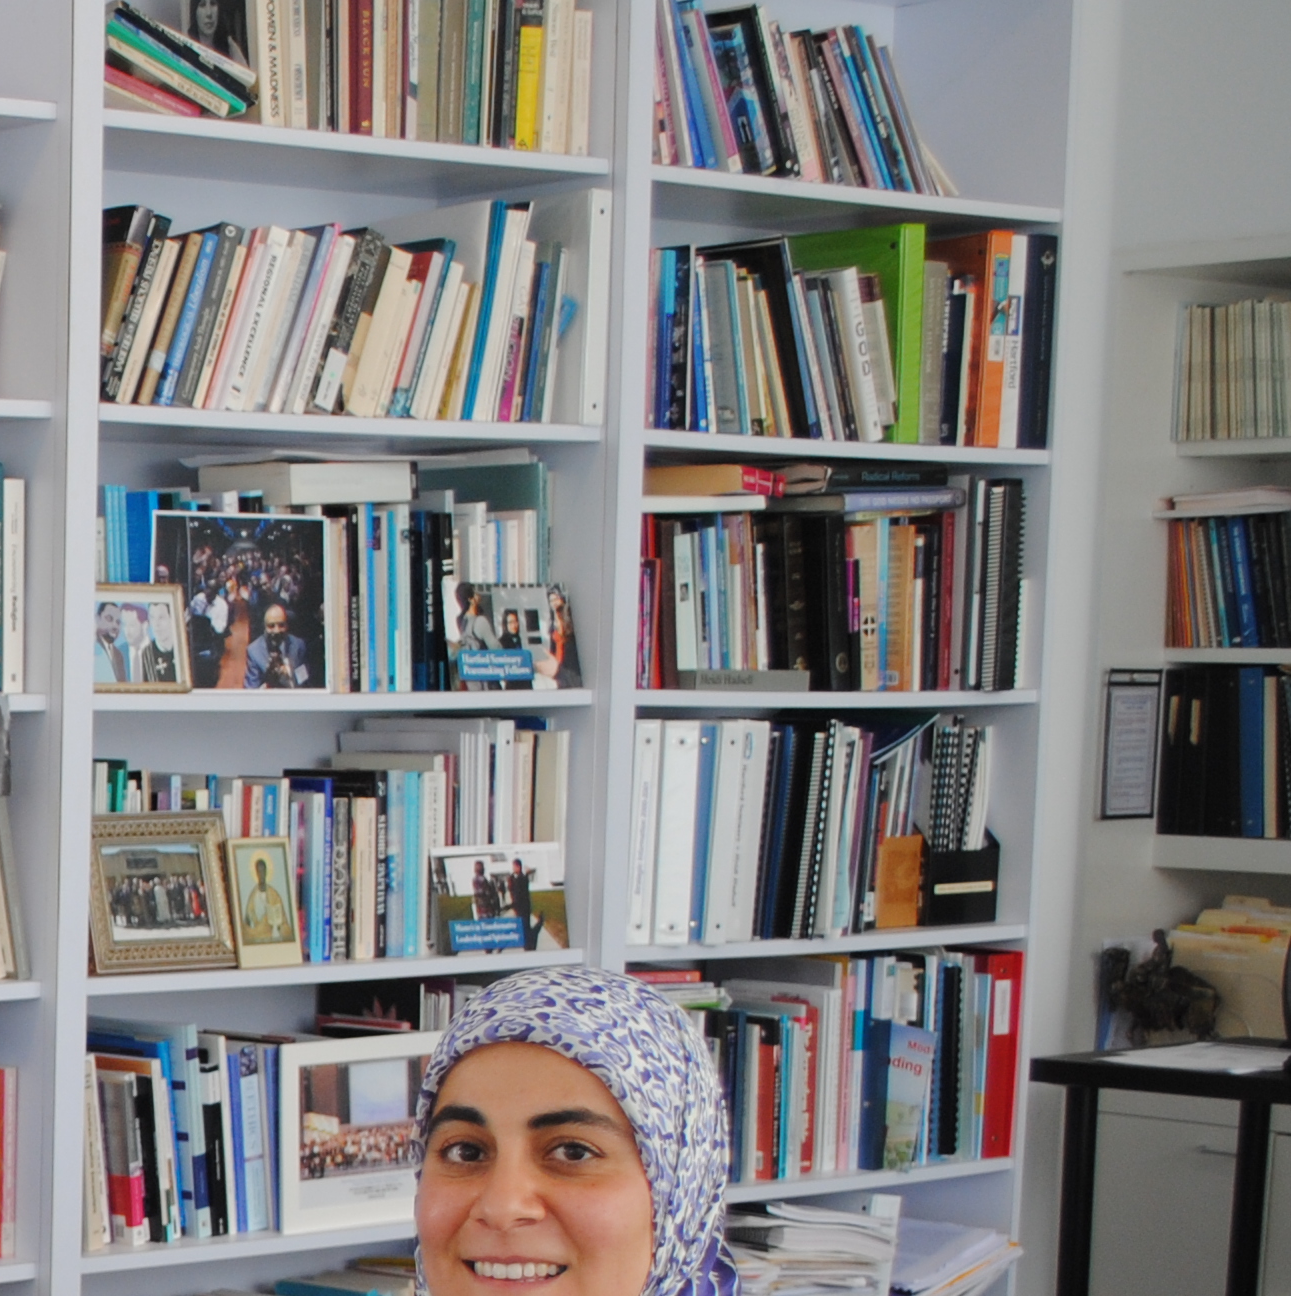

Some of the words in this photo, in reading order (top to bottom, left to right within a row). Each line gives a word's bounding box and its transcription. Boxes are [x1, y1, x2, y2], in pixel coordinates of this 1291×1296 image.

[361, 10, 370, 53] BLACK
[266, 56, 280, 117] MADNESS
[362, 59, 371, 87] SUN
[256, 254, 277, 309] REGIONAL
[237, 311, 261, 378] EXCELLENCE
[1007, 339, 1018, 388] Hartford
